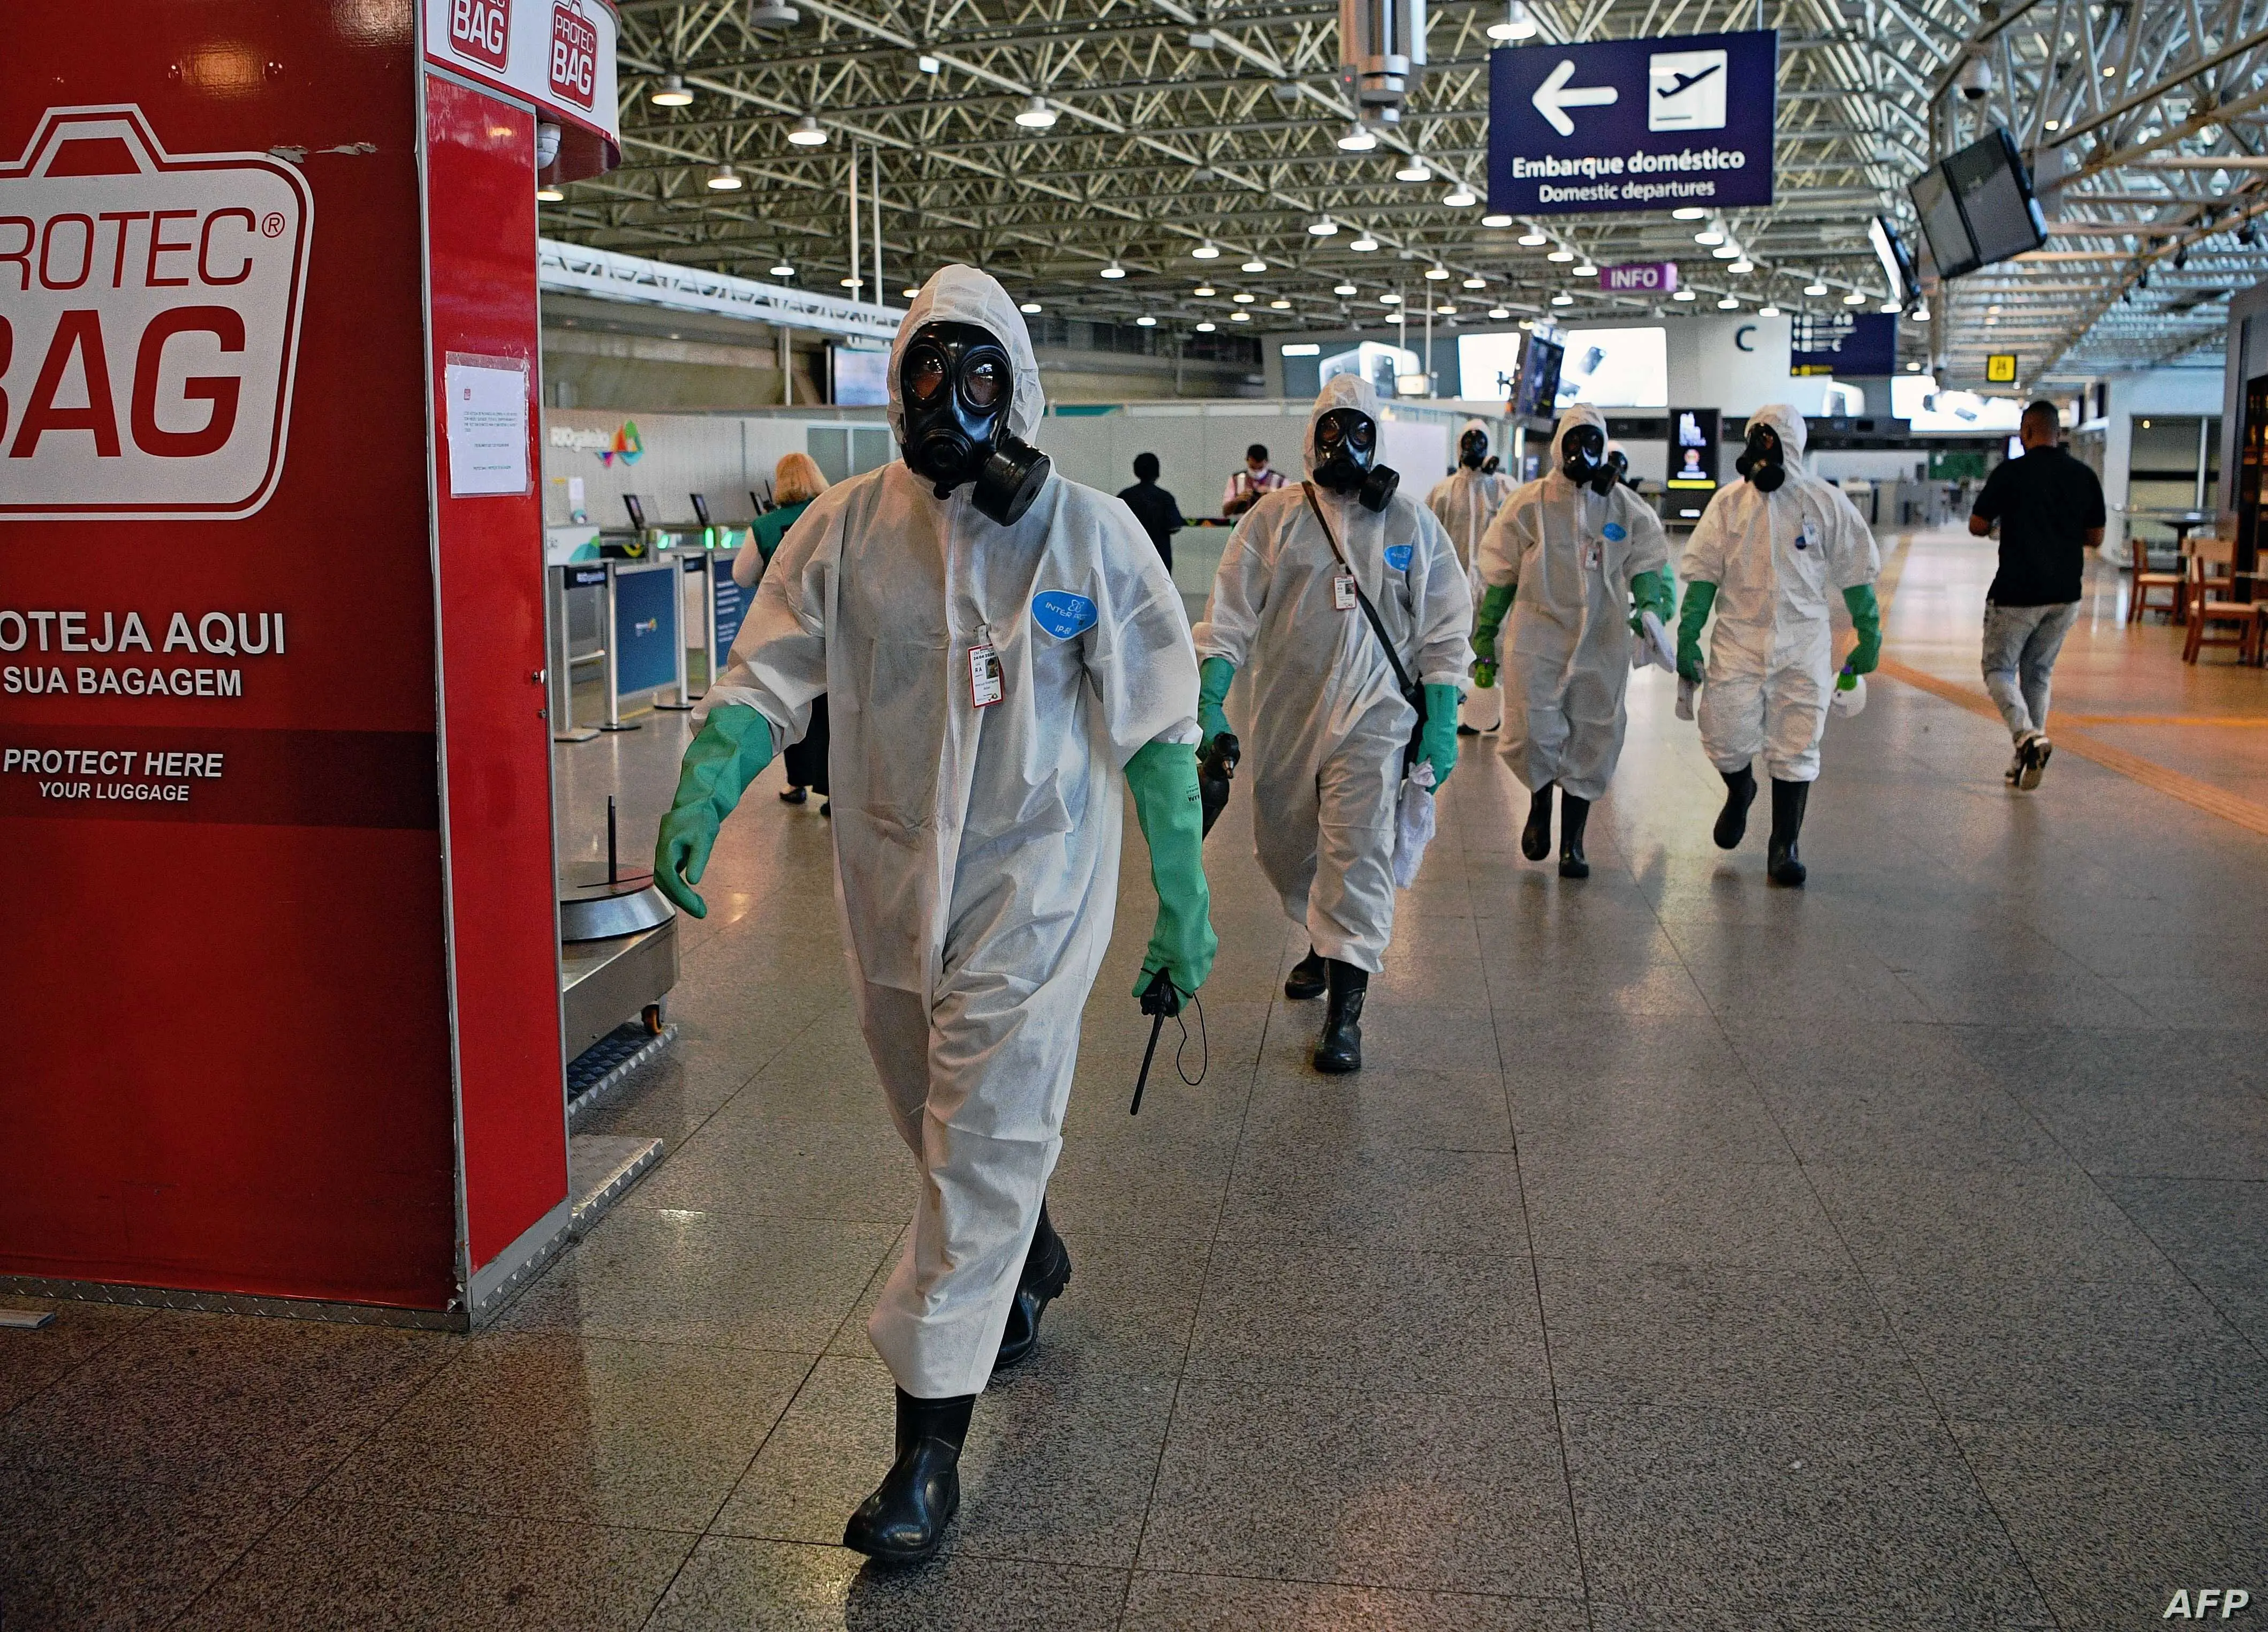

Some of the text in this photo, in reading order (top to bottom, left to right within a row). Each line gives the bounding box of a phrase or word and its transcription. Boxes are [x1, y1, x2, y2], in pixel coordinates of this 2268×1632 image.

[453, 0, 504, 54] BAG
[555, 14, 595, 54] PROTEC
[552, 40, 592, 95] BAG
[1512, 147, 1746, 179] Embarque doméstico
[1539, 181, 1715, 202] Domestic departures
[1610, 270, 1658, 288] INFO
[0, 306, 245, 458] AG
[0, 611, 285, 656] OTEJA AQUI
[3, 666, 242, 696] SUA BAGAGEM
[3, 750, 224, 777] PROTECT HERE
[39, 782, 189, 801] YOUR LUGGAGE
